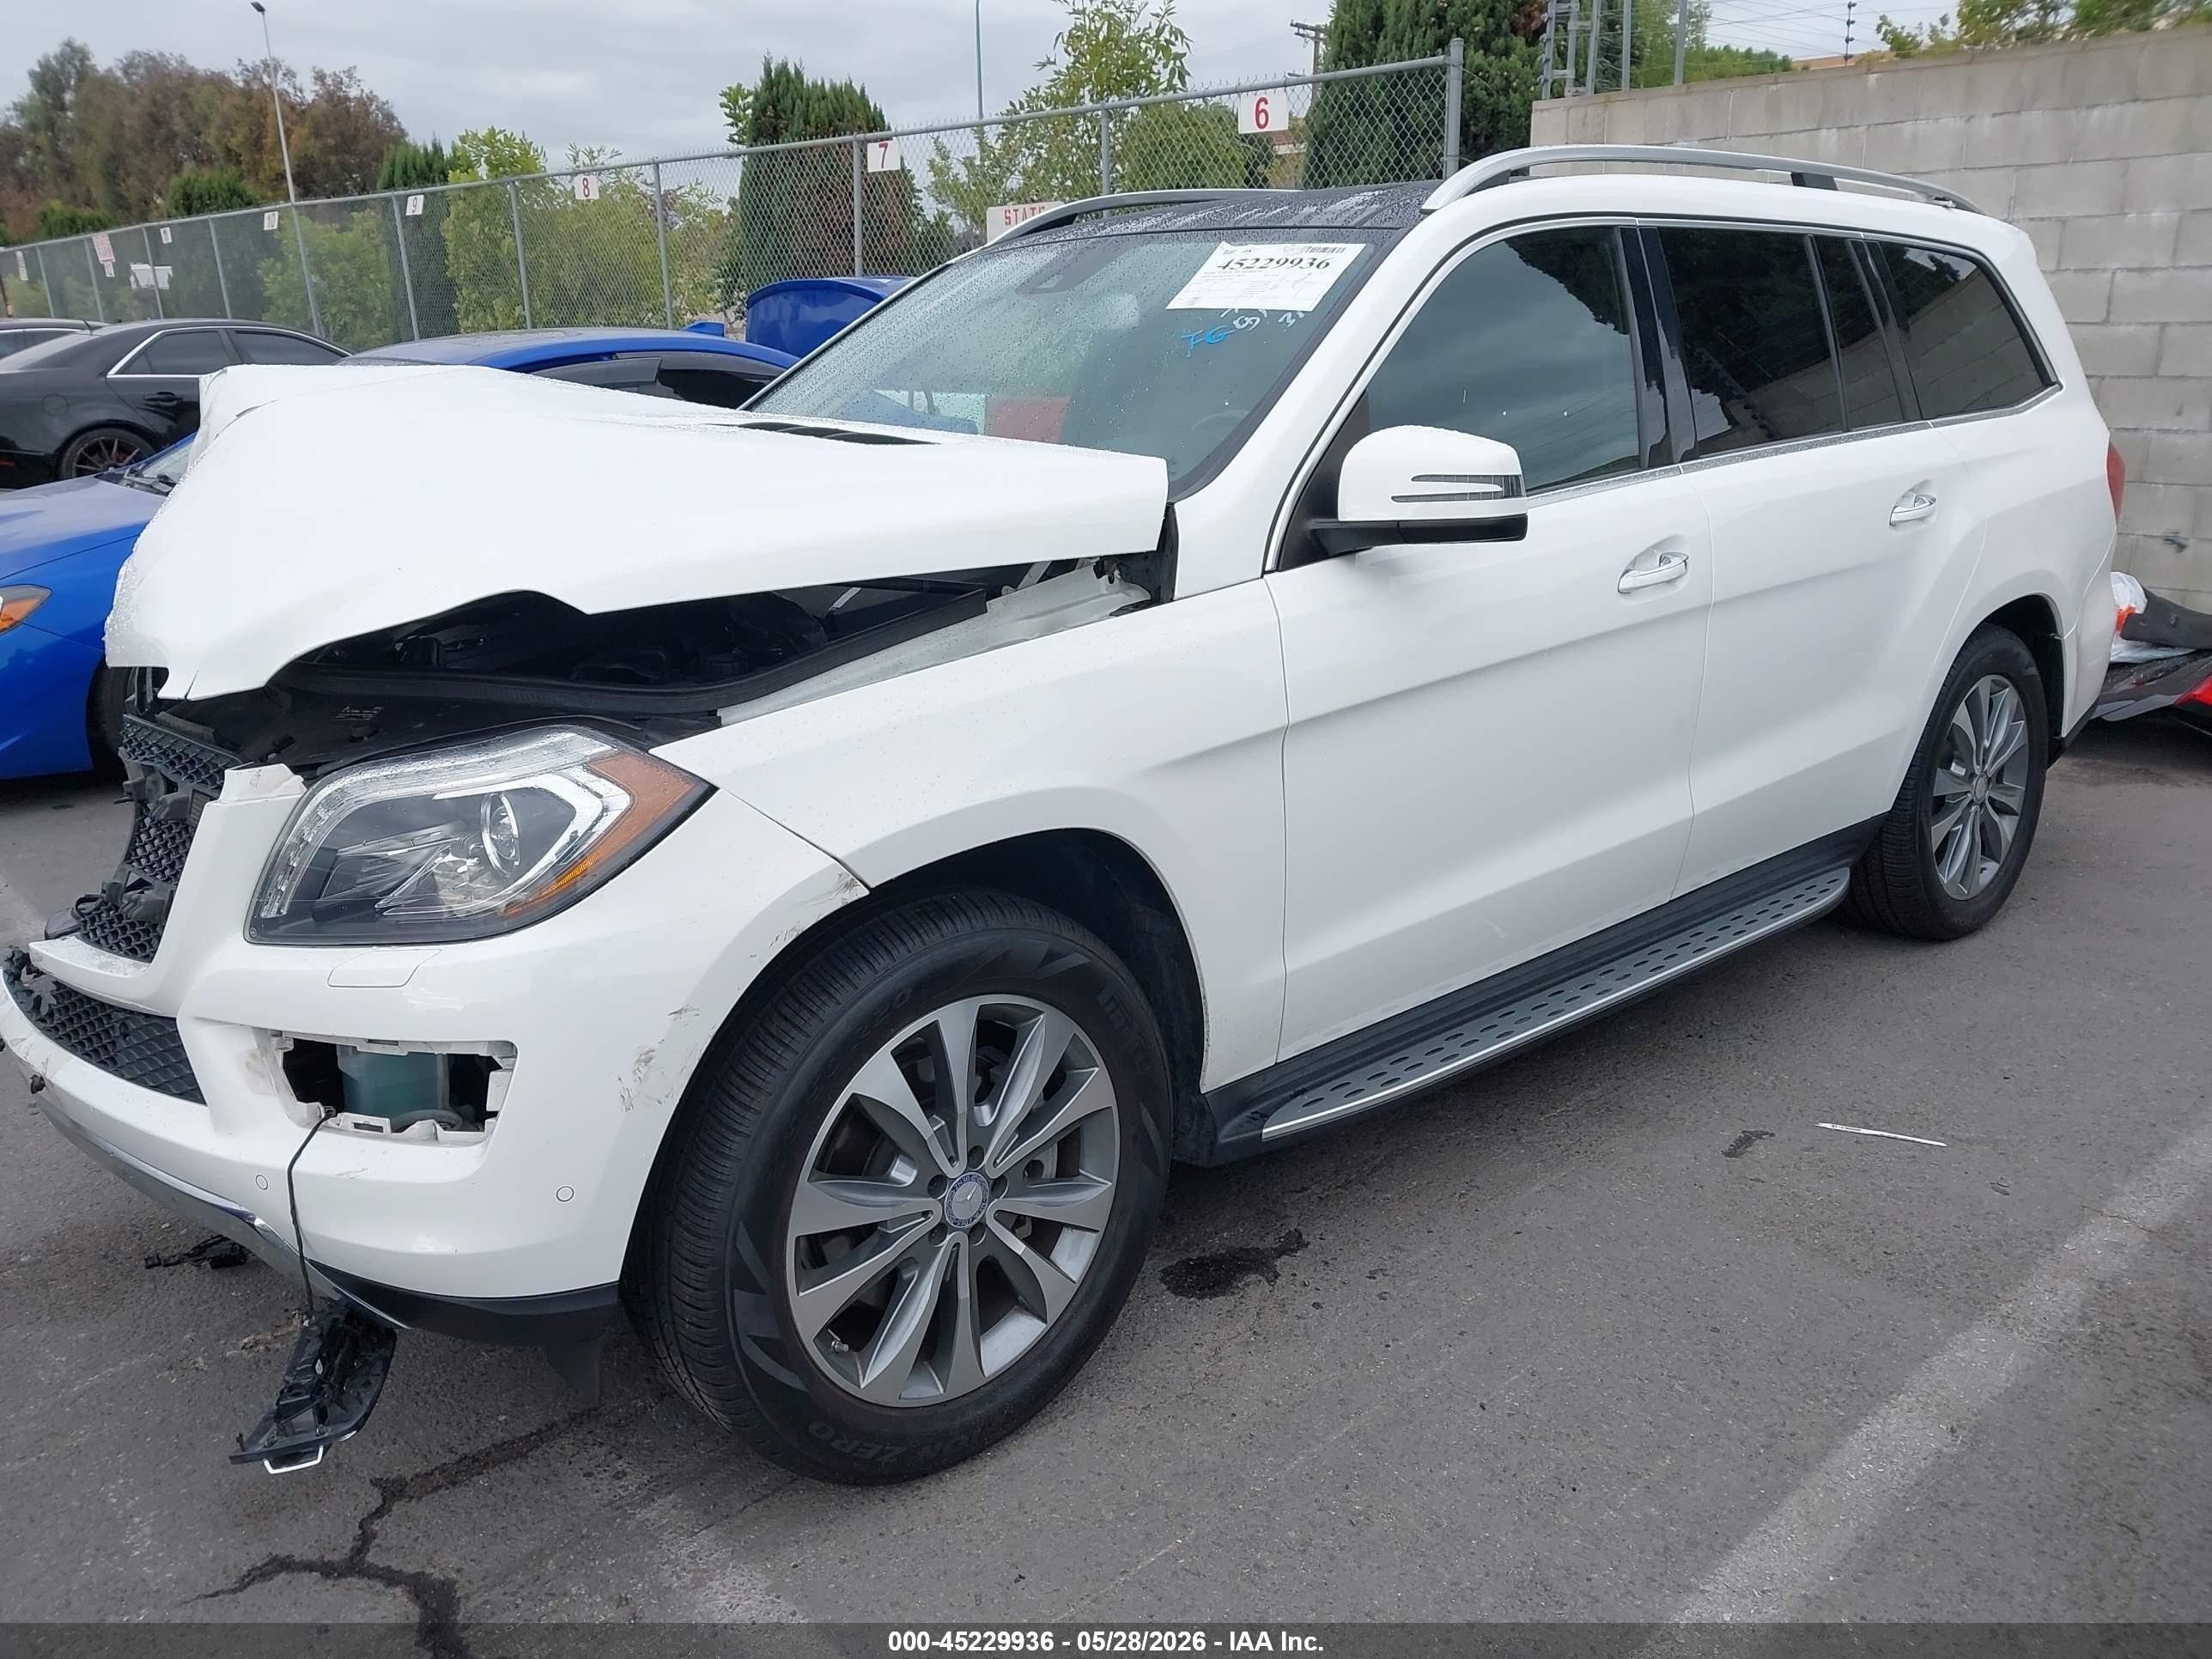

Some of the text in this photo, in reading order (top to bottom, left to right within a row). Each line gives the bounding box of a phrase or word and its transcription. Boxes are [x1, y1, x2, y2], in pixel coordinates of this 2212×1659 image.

[1255, 97, 1268, 130] 6
[878, 142, 889, 168] 7
[582, 178, 591, 198] 8
[412, 193, 418, 213] 9
[1218, 257, 1334, 270] 45229936
